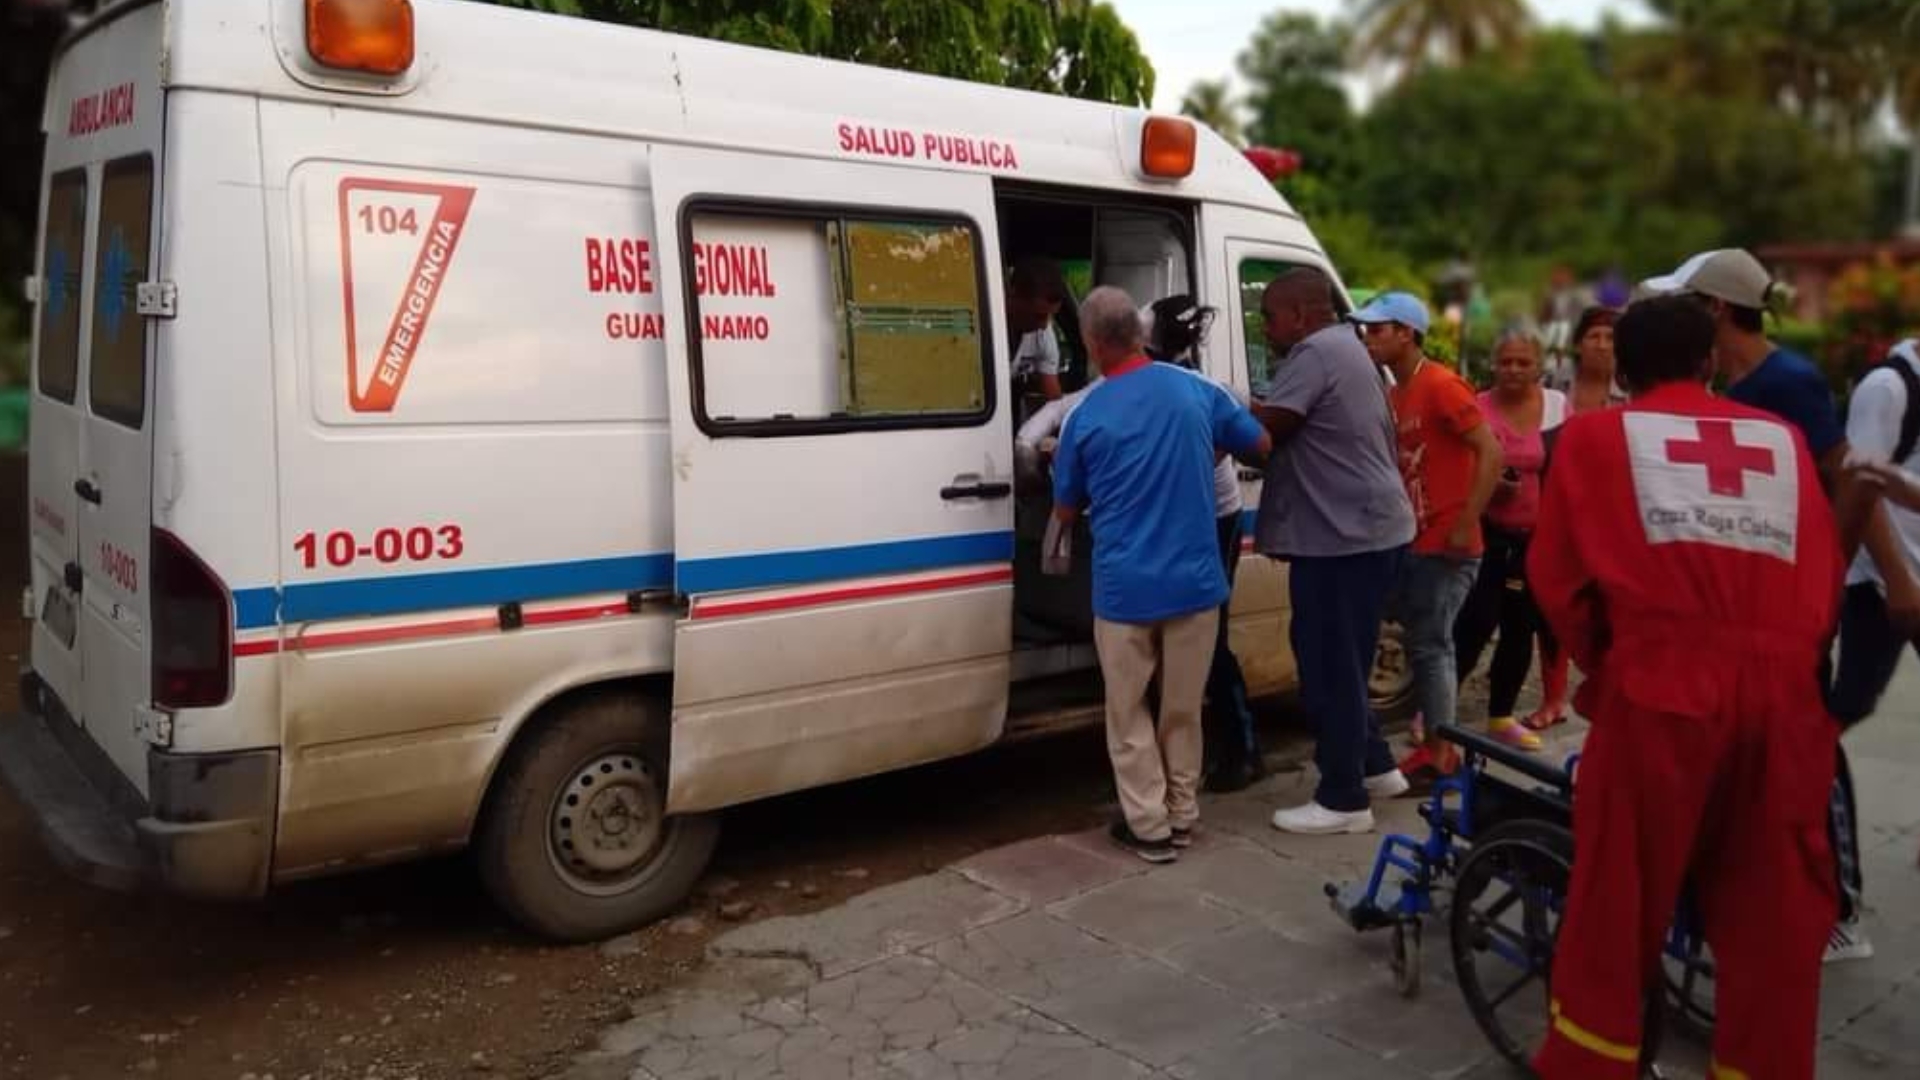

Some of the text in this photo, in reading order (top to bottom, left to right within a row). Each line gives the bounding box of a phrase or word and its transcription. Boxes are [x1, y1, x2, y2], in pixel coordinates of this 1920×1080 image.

[838, 123, 1018, 170] SALUD PUBLICA
[358, 205, 419, 236] 104
[585, 237, 776, 297] BASE GIONAL
[378, 219, 457, 387] EMERGENCIA
[606, 313, 770, 341] GUANAMO
[294, 525, 464, 569] 10-003
